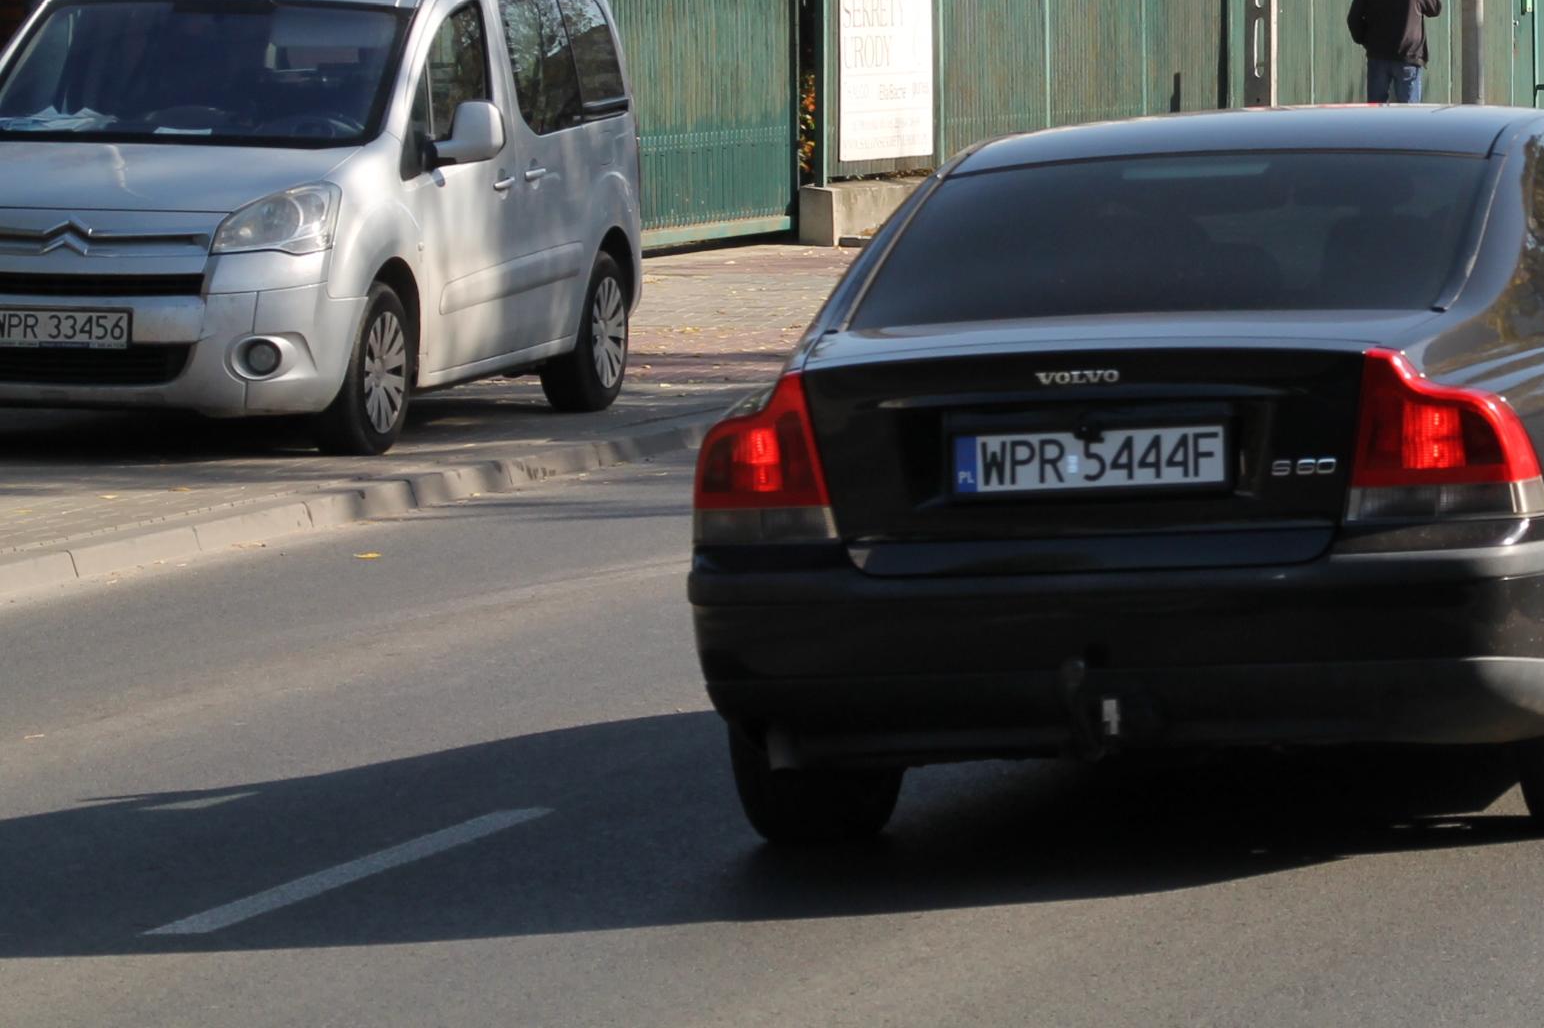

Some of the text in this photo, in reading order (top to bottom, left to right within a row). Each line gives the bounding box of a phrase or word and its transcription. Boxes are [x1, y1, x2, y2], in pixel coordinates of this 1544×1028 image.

[844, 34, 892, 69] URODY
[48, 314, 124, 340] 33456
[1035, 369, 1120, 385] VOLVO
[958, 432, 1219, 487] PL WPR 5444F
